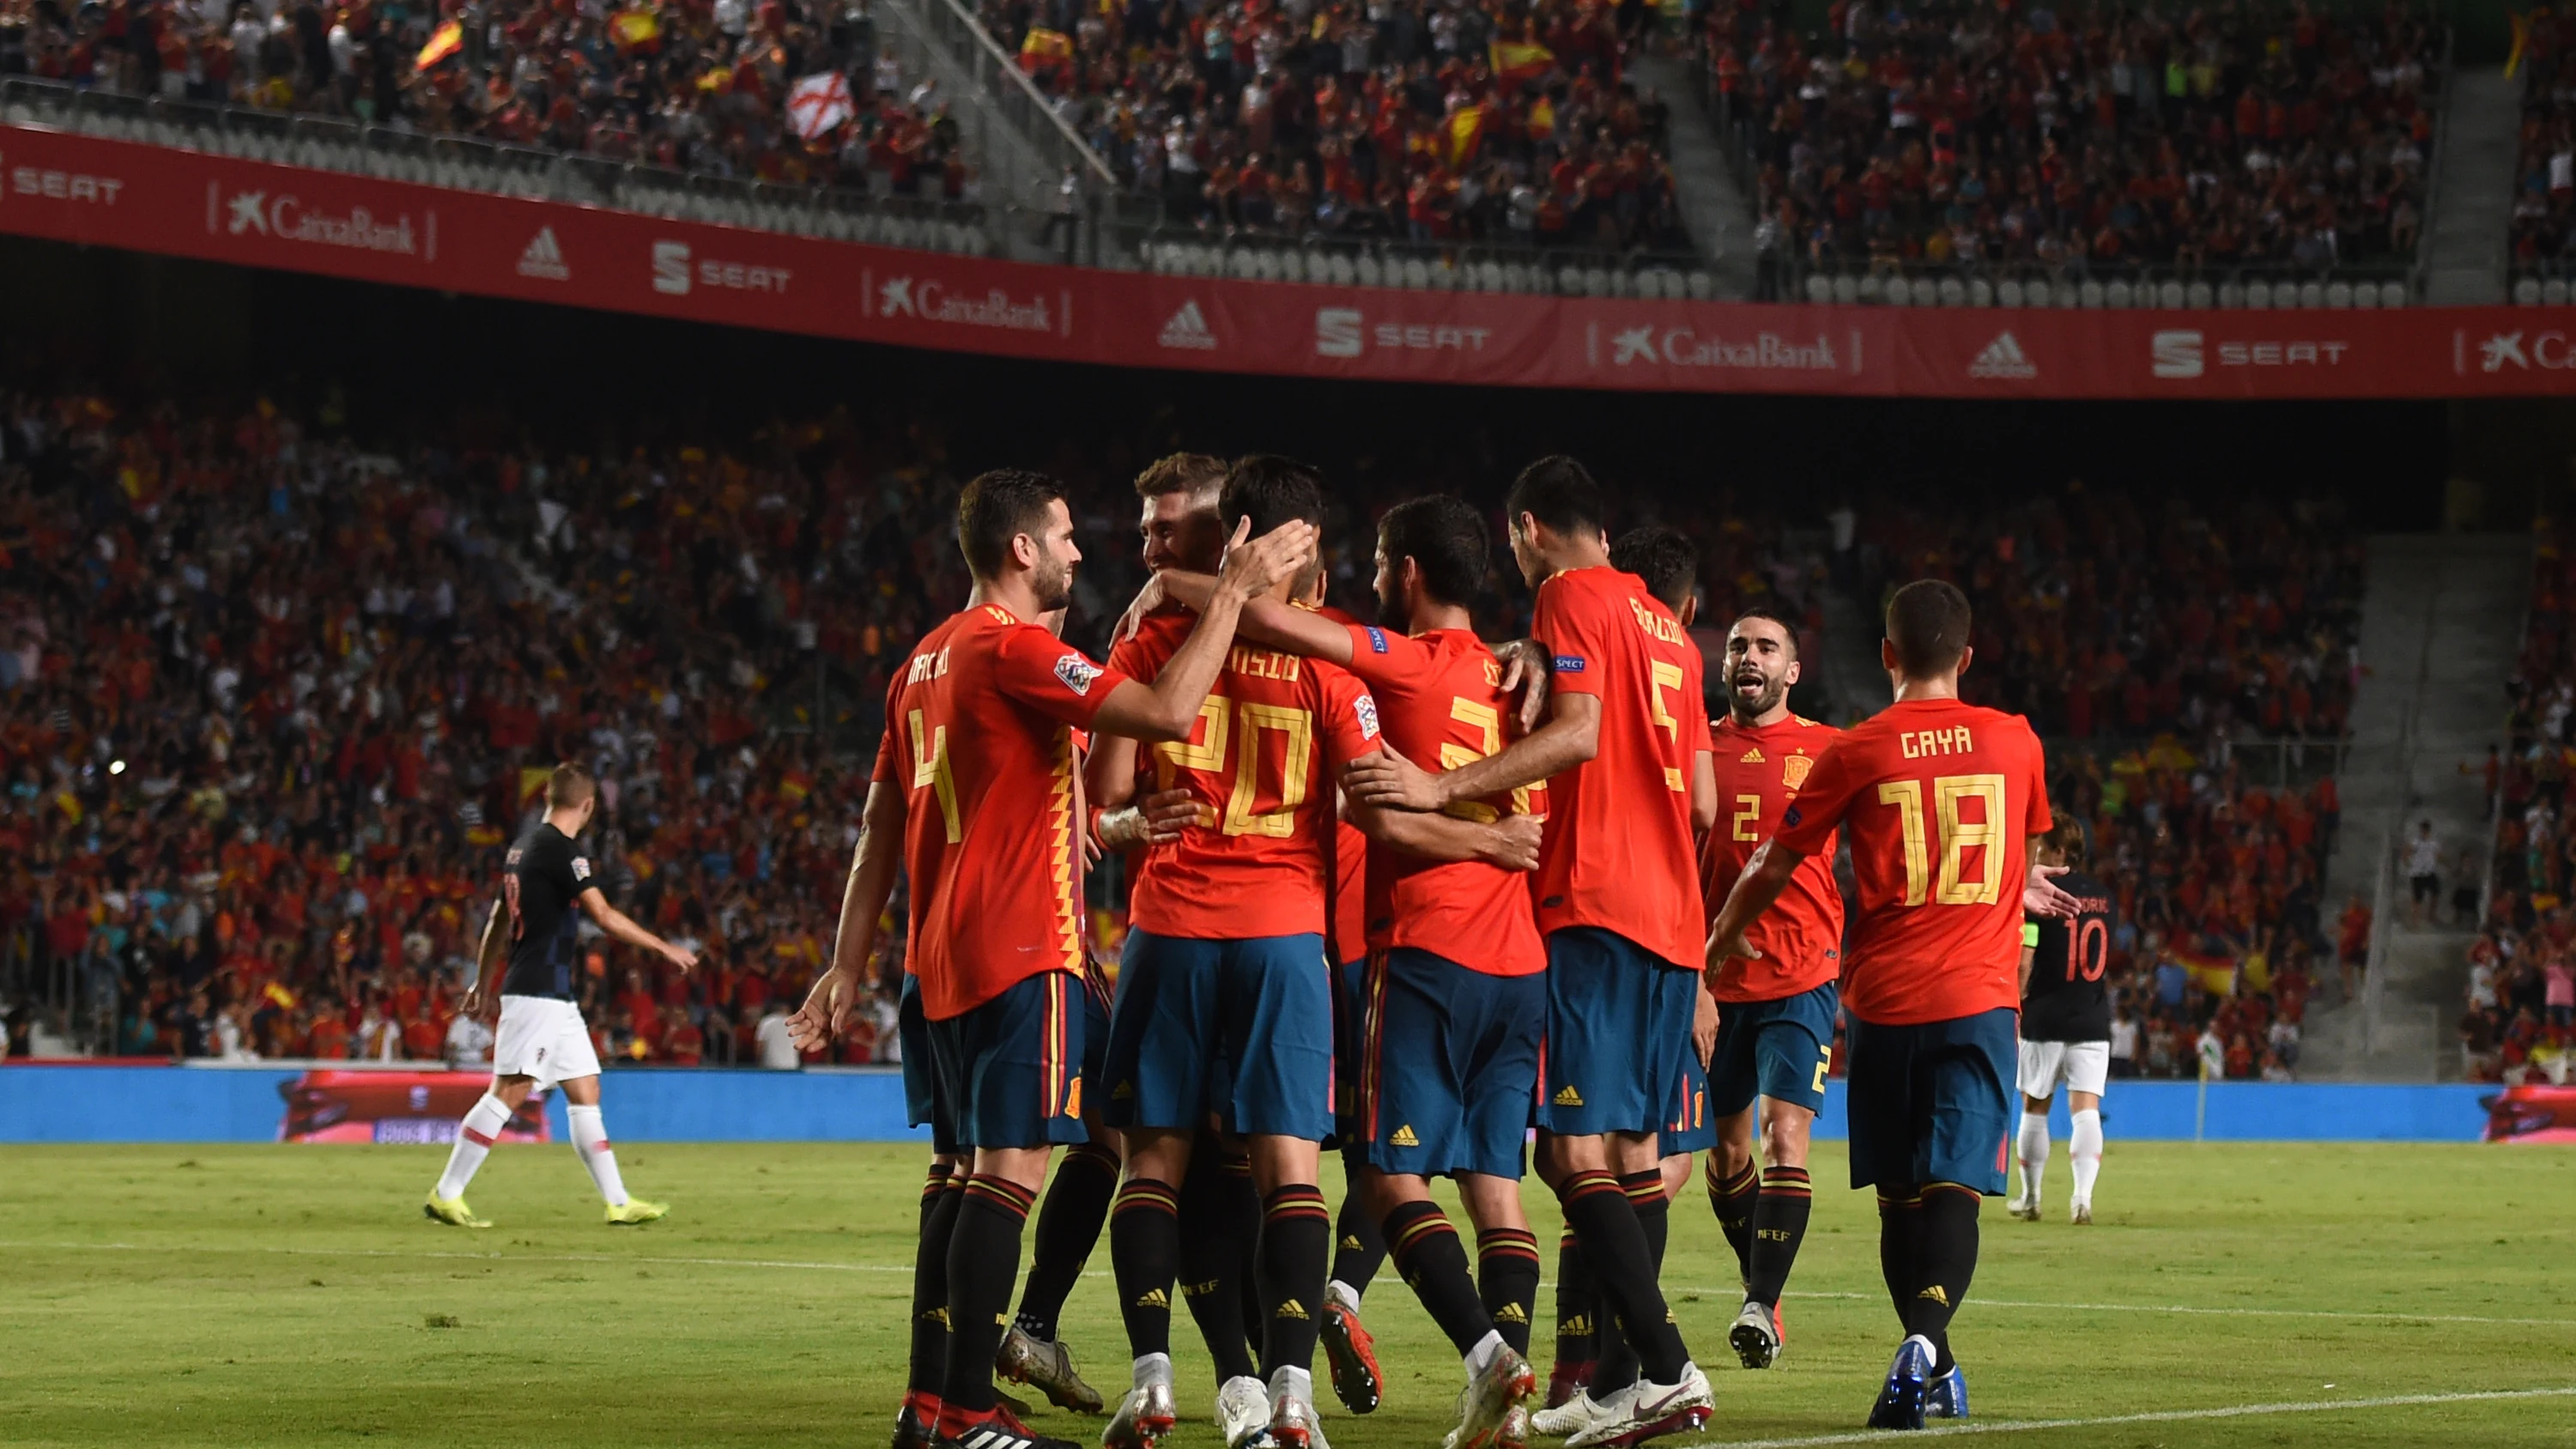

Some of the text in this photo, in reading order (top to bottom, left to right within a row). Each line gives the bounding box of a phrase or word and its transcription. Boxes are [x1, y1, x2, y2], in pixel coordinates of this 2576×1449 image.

[13, 167, 123, 204] SEAT
[699, 260, 792, 294] SEAT
[1374, 323, 1492, 350] SEAT
[1663, 327, 1836, 369] CaixaBank
[2218, 343, 2349, 366] SEAT
[1651, 658, 1685, 792] 5
[908, 709, 962, 845] 4
[1154, 694, 1312, 839] 20
[1733, 794, 1761, 842] 2
[1877, 774, 2006, 906] 18
[2064, 918, 2108, 982] 10
[1812, 1044, 1832, 1095] 2
